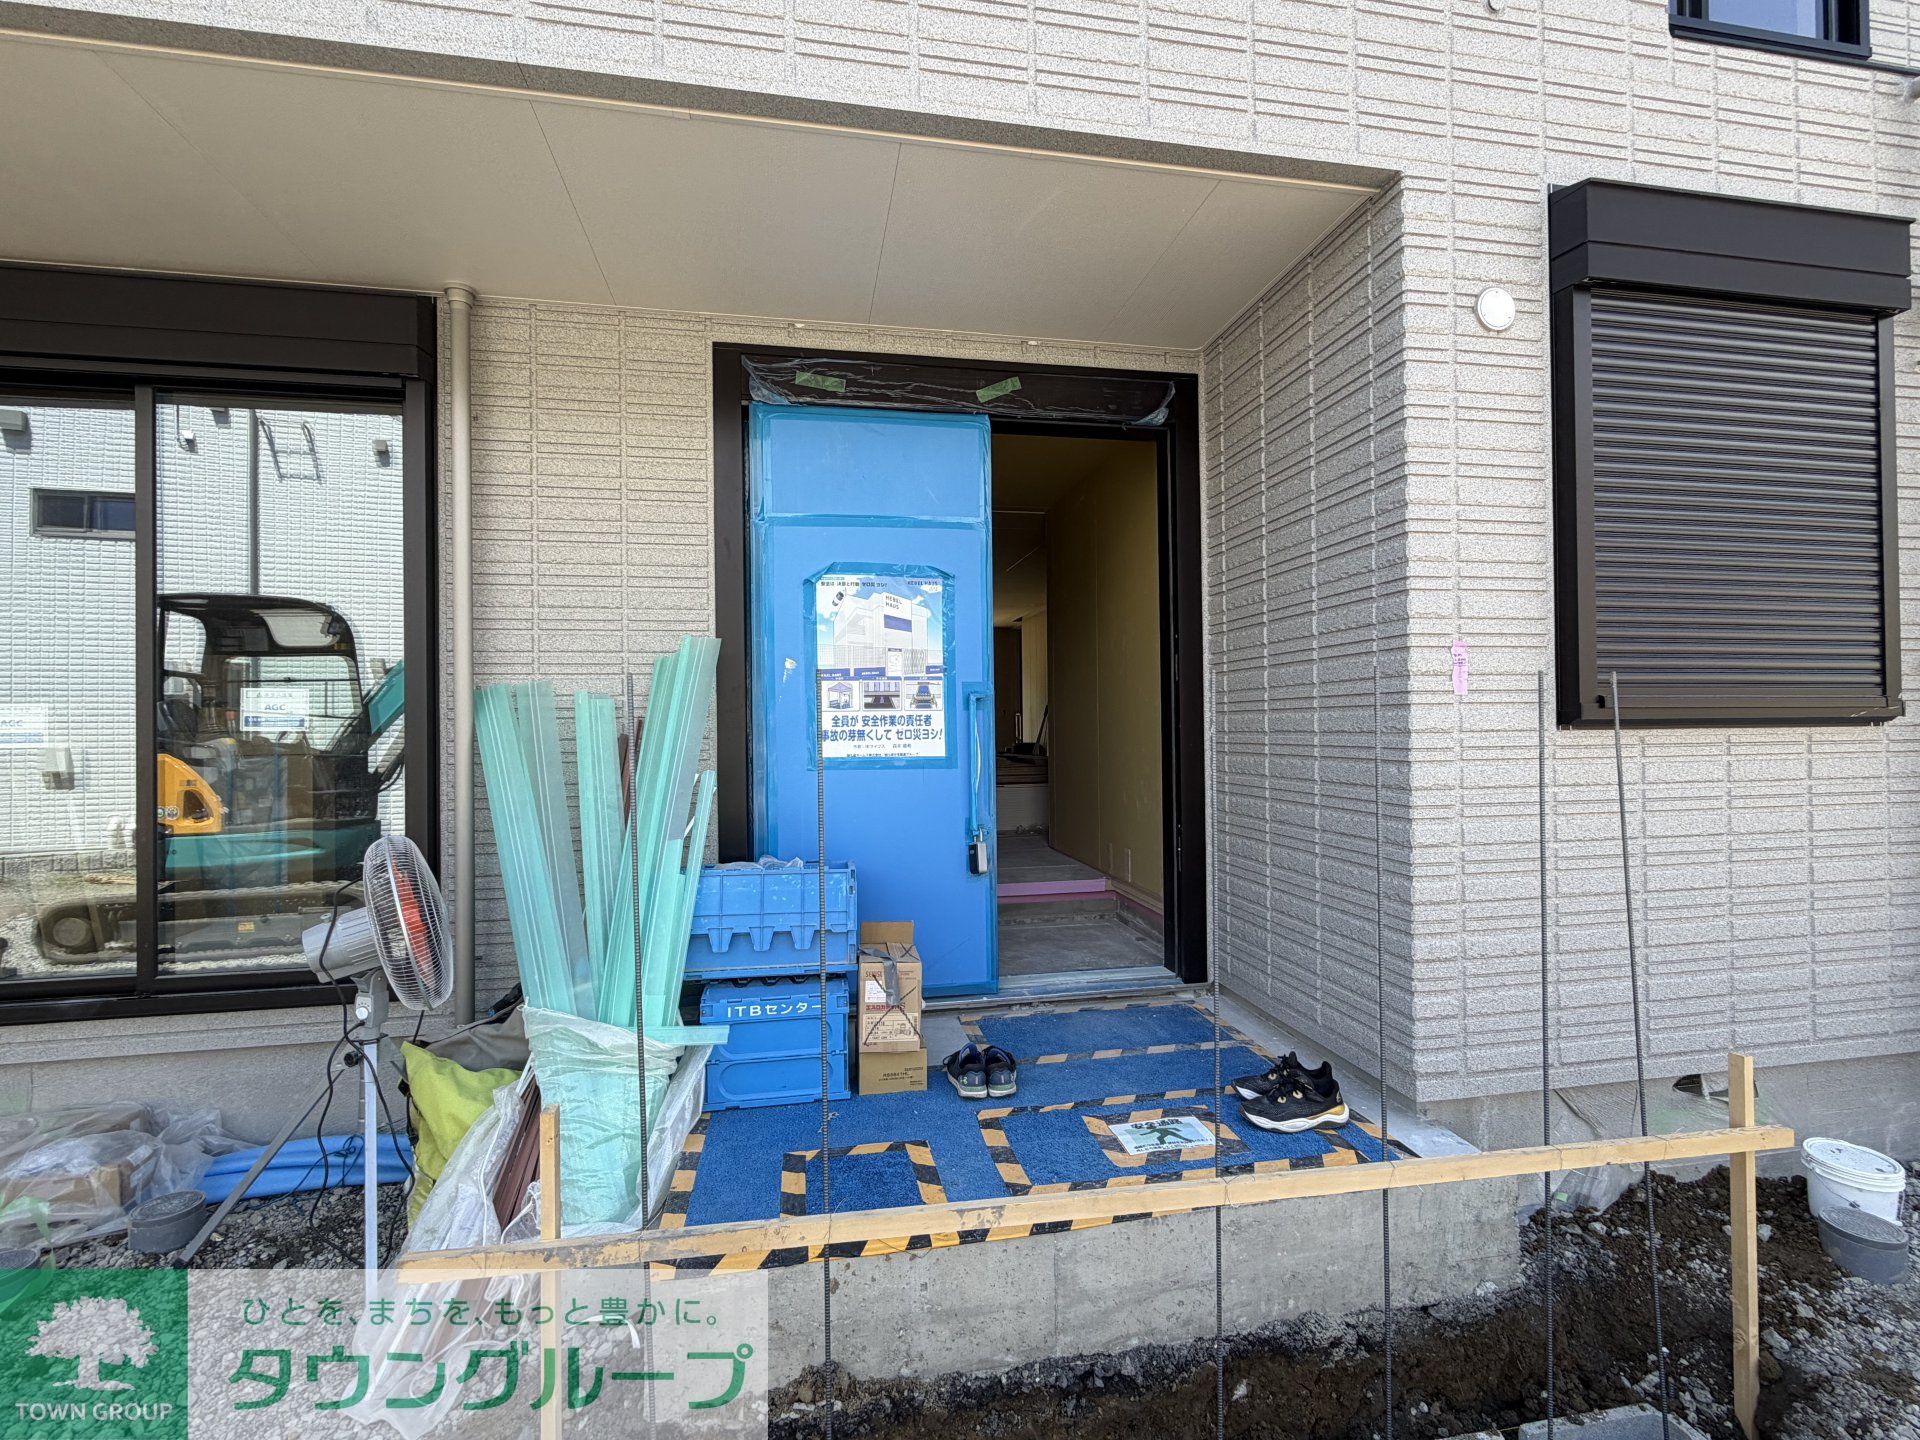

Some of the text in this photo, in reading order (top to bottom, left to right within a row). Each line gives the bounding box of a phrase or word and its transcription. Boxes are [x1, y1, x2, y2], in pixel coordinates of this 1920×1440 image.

[831, 714, 932, 727] 全員が 安全作業の責任者
[895, 728, 943, 741] ゼロ災ヨシ!
[727, 1001, 822, 1018] ITBセンター
